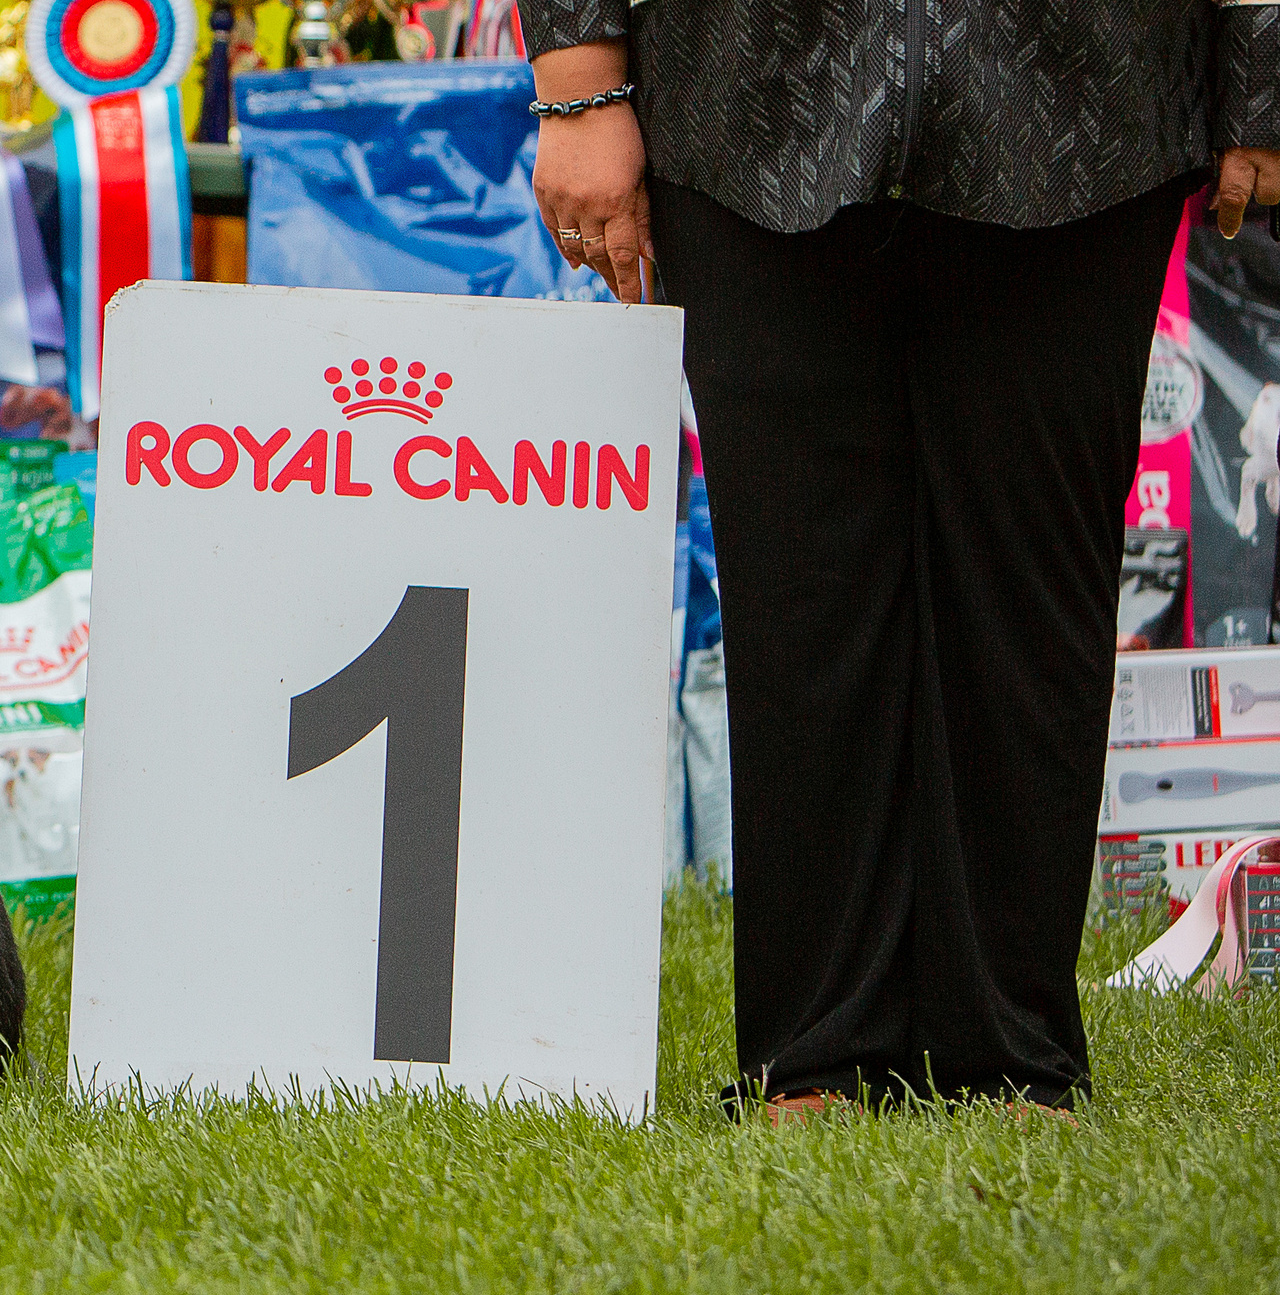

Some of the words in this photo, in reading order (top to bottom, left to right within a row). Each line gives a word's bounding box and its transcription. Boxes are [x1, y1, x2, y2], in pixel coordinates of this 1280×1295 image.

[125, 420, 373, 498] ROYAL
[393, 434, 651, 512] CANIN
[286, 585, 470, 1065] 1
